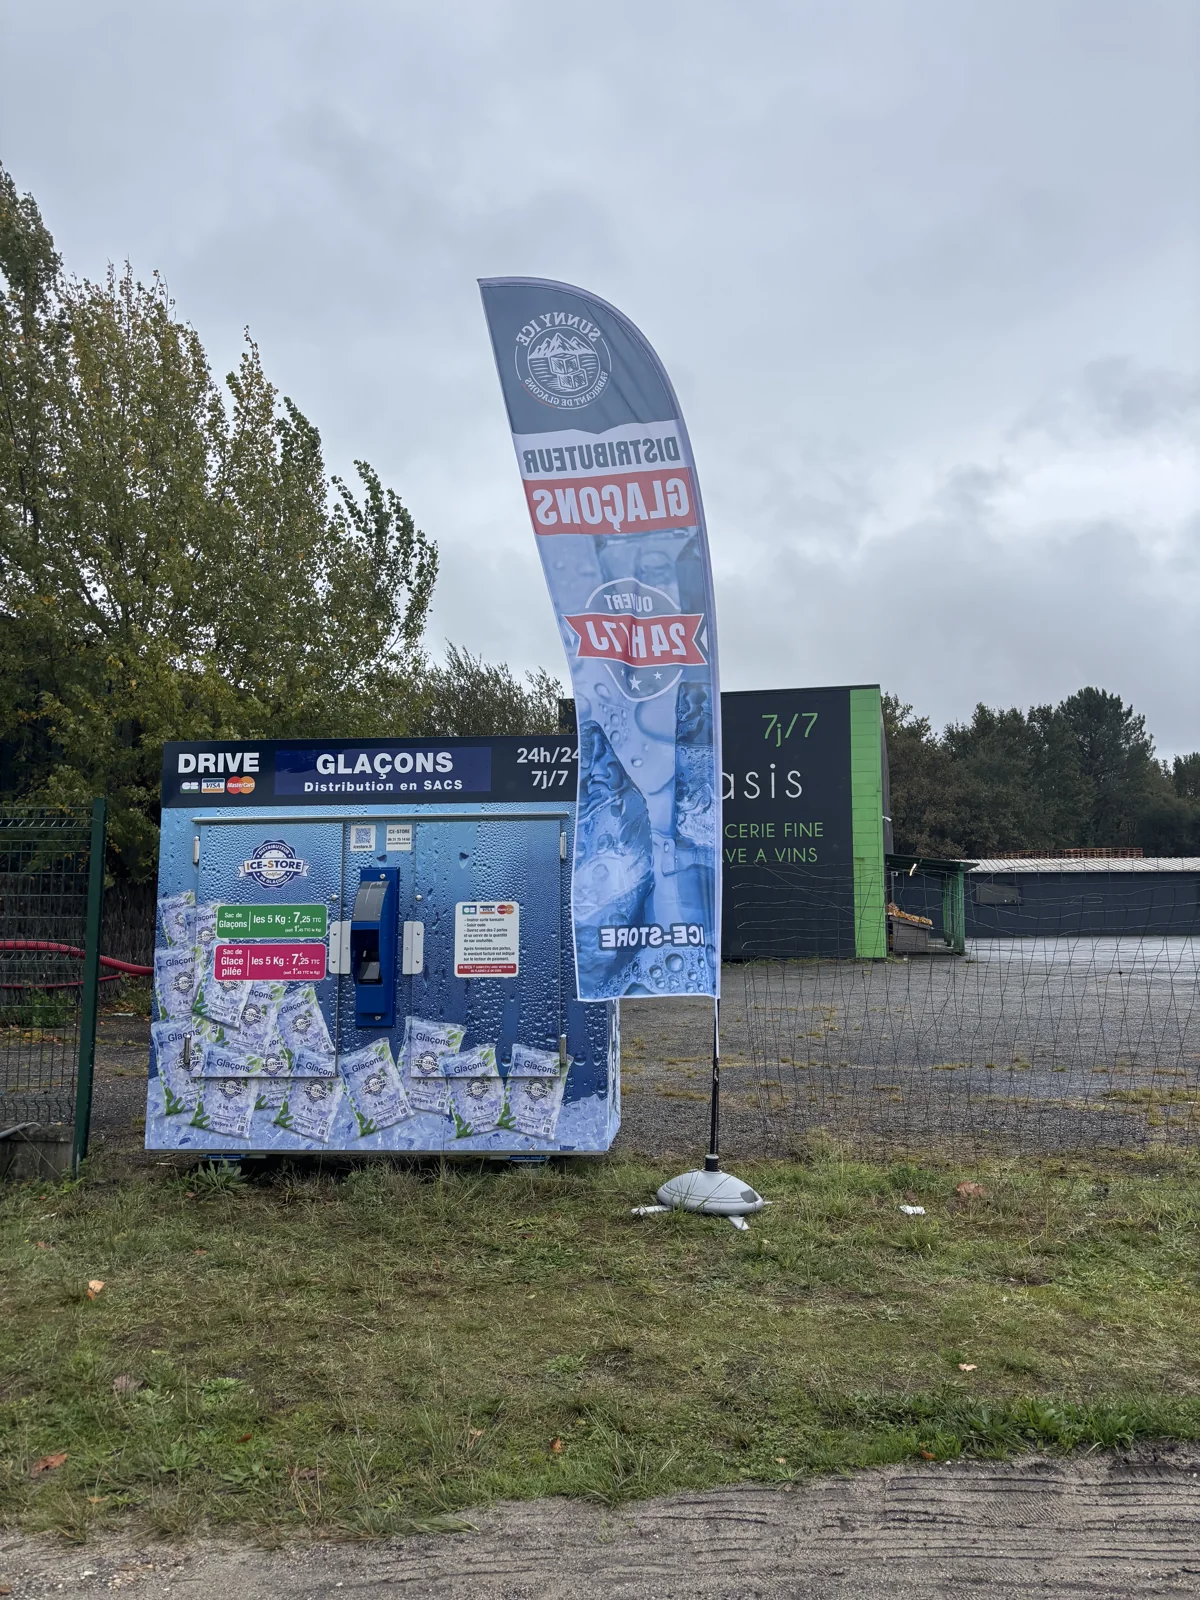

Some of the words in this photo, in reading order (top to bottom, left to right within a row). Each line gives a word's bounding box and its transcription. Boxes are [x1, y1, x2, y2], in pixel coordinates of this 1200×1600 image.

[761, 712, 818, 747] 7j/7
[177, 752, 260, 774] DRIVE
[316, 751, 454, 780] GLAÇONS
[304, 781, 394, 792] Distribution
[423, 779, 463, 791] SACS
[531, 770, 569, 790] 7j/7
[784, 822, 824, 838] FINE
[722, 848, 747, 863] VE
[755, 848, 767, 863] A
[774, 847, 818, 863] VINS
[246, 860, 302, 871] ICE-STORE
[218, 920, 248, 930] Glaçons
[253, 915, 266, 924] les
[267, 915, 273, 924] 5
[275, 914, 286, 925] Kg
[220, 956, 244, 966] Glace
[251, 956, 264, 966] les
[265, 956, 271, 966] 5
[273, 956, 284, 967] Kg
[221, 966, 242, 977] pilée
[415, 1032, 451, 1047] Glaçons
[216, 1058, 251, 1073] Glaçons
[351, 1056, 384, 1073] Glaçons
[453, 1060, 487, 1074] Glaçons
[523, 1060, 558, 1075] Glaçons
